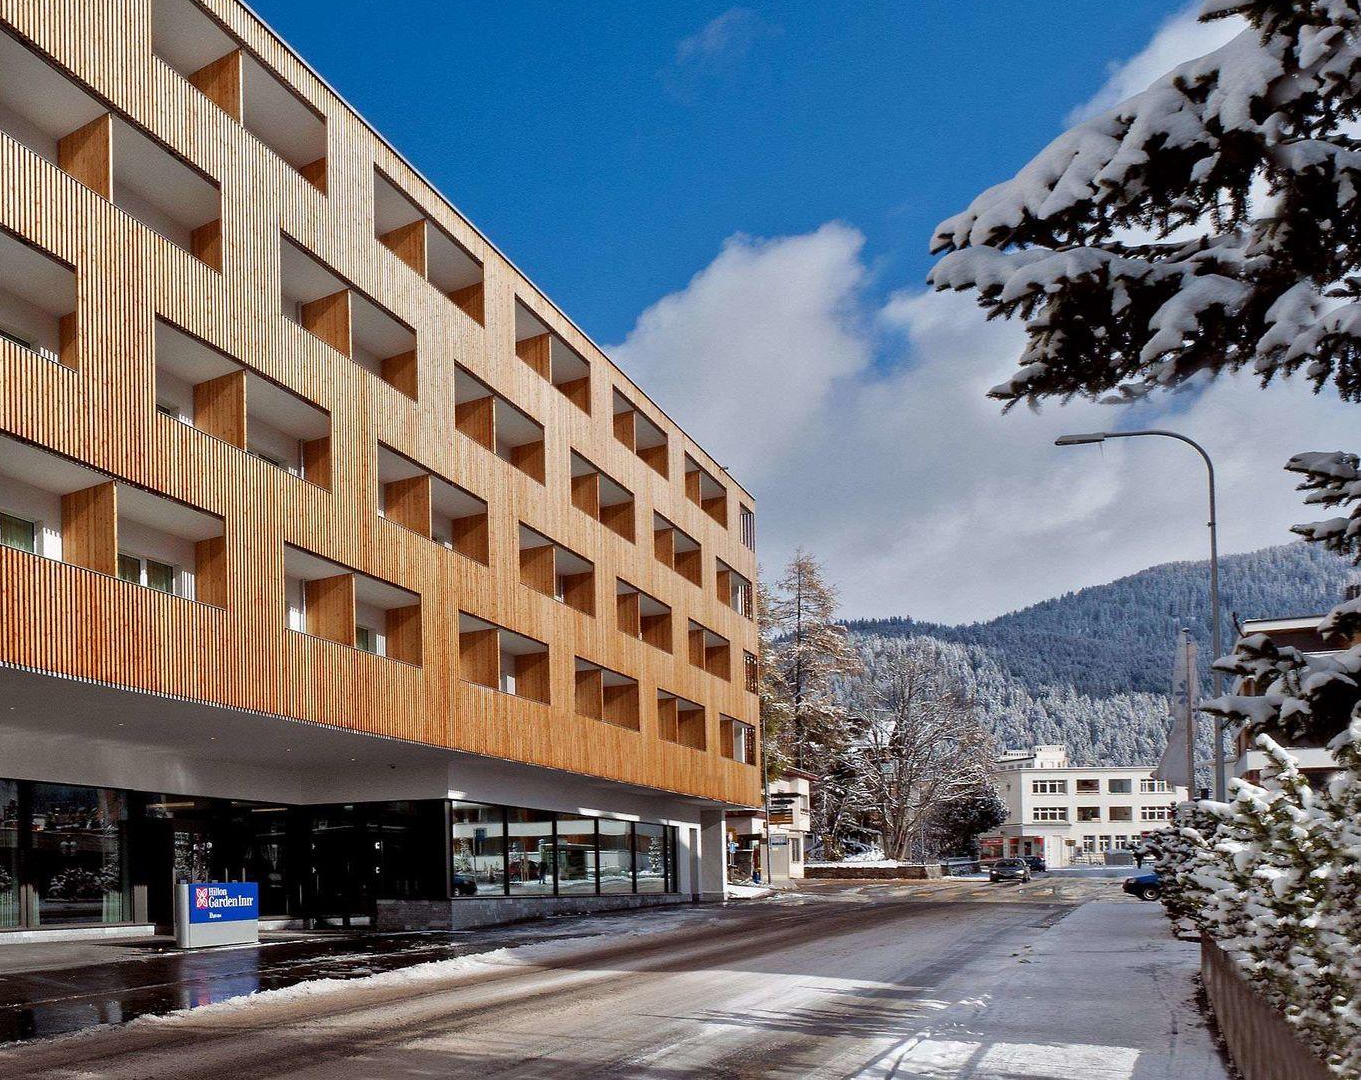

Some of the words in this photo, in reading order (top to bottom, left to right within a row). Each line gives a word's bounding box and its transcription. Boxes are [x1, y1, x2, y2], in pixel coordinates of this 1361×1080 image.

[208, 887, 227, 896] Hilton
[208, 895, 238, 908] Garden
[238, 895, 252, 906] Inn
